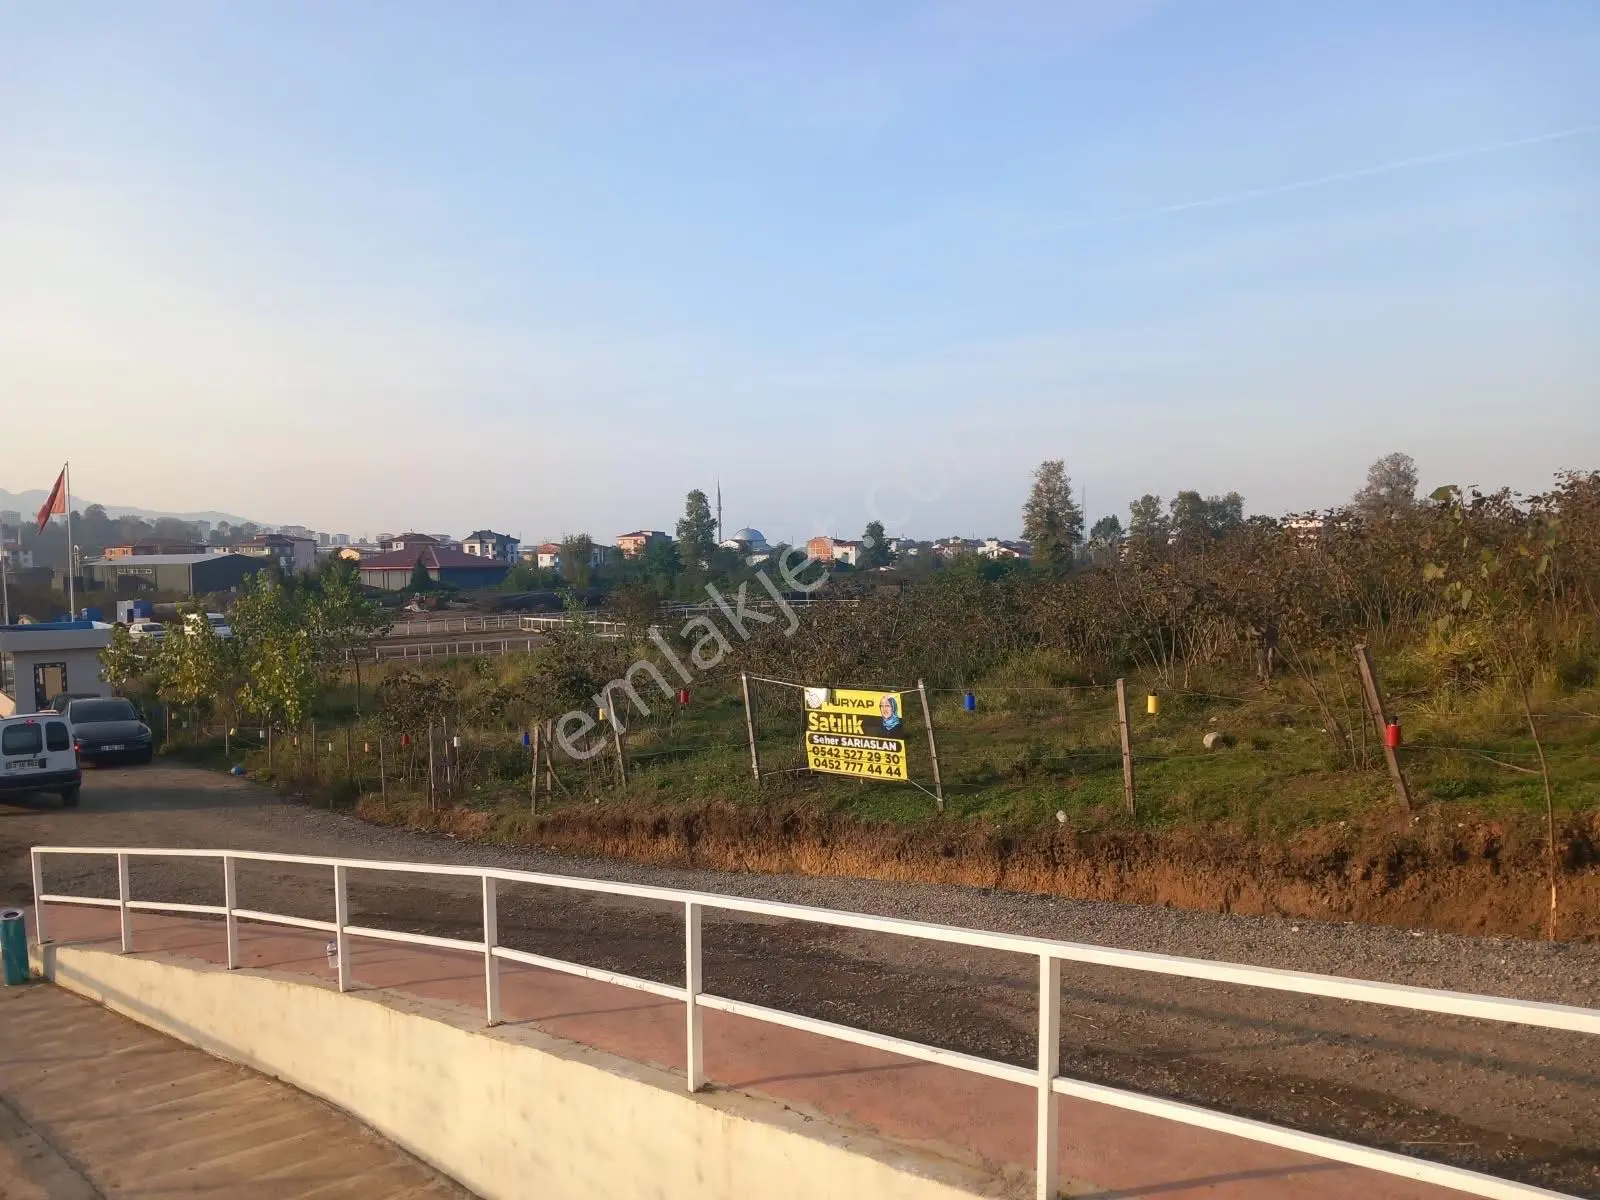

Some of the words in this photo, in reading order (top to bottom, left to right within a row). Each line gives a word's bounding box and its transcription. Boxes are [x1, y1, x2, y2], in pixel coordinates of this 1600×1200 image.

[808, 711, 865, 735] Satılık
[812, 734, 840, 746] Seher
[840, 738, 897, 752] SARIASLAN
[812, 745, 840, 758] 0542
[843, 749, 863, 761] 527
[867, 752, 882, 763] 29
[885, 753, 900, 765] 30
[813, 757, 842, 770] 0452
[844, 761, 863, 773] 777
[867, 764, 882, 775] 44
[885, 766, 901, 777] 44
